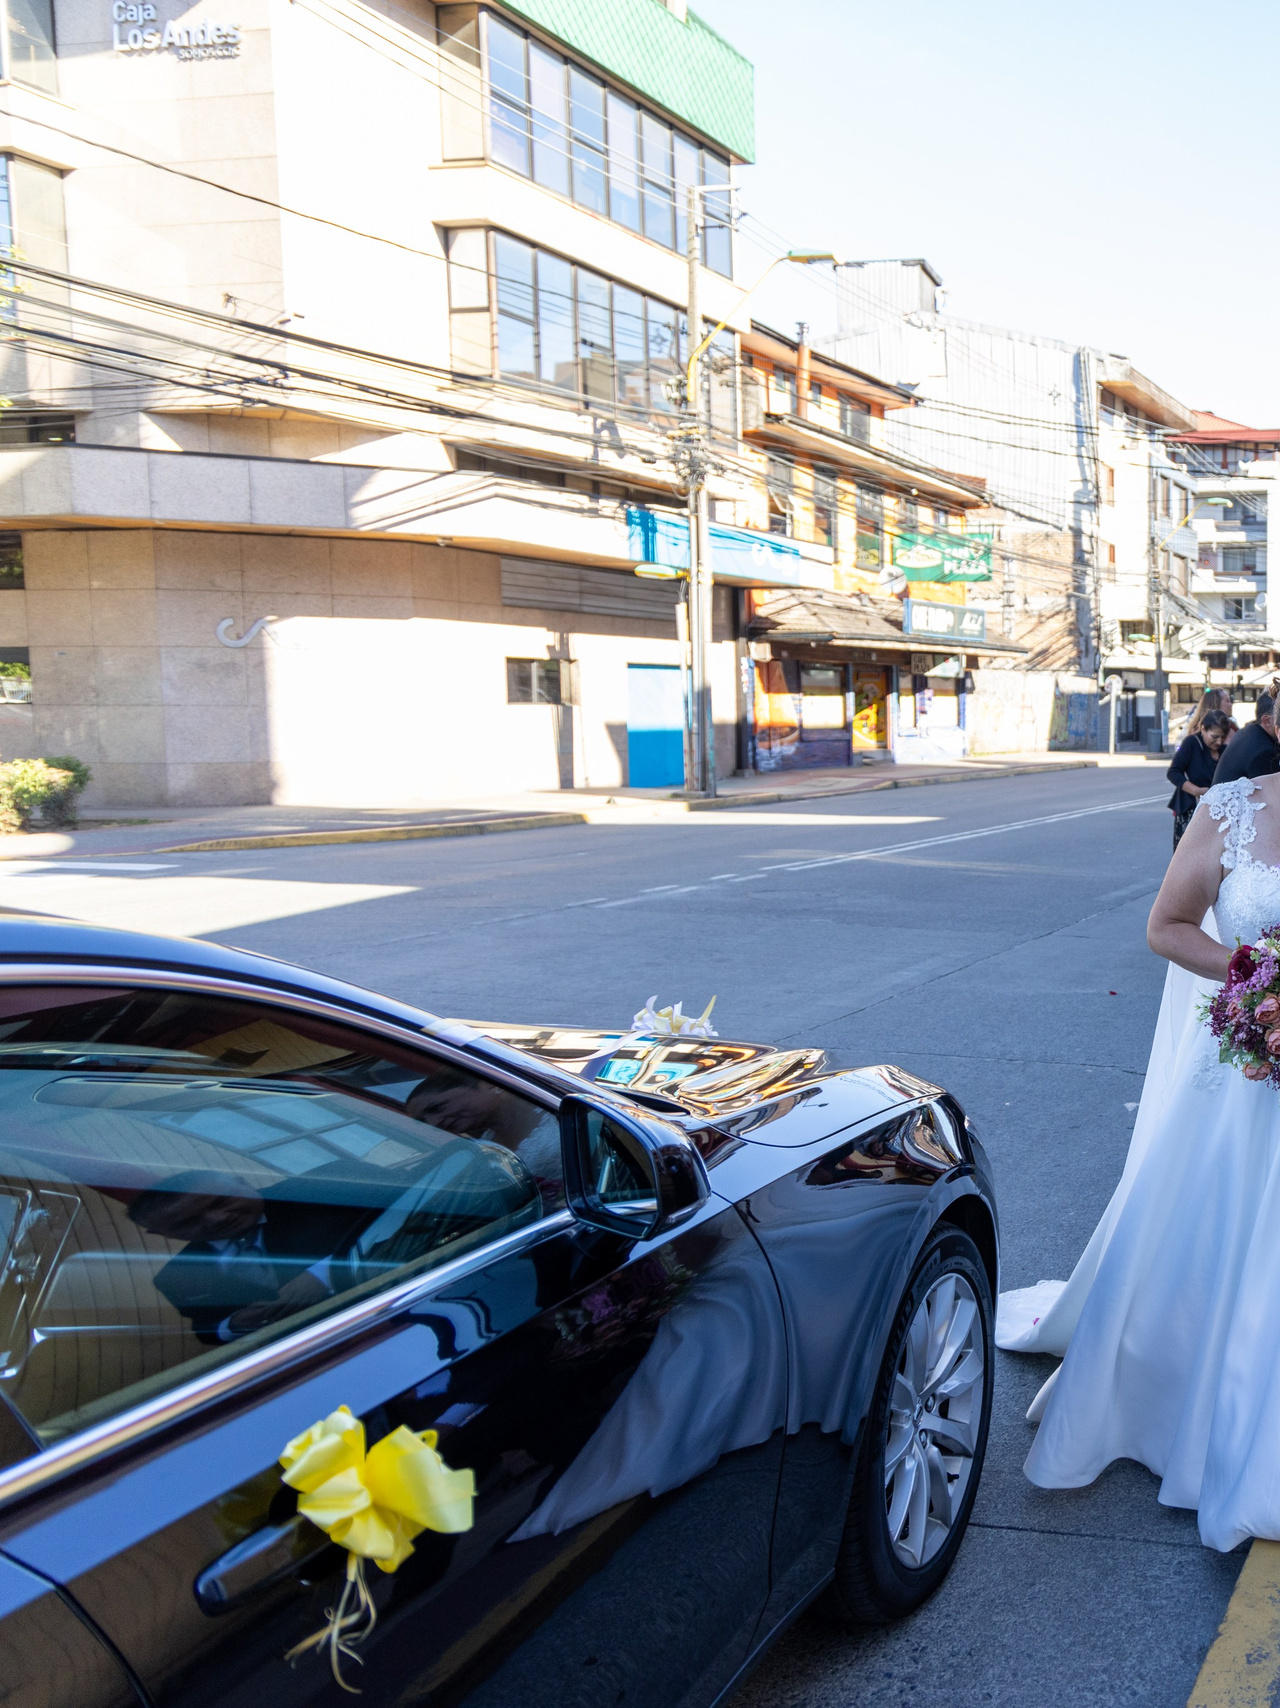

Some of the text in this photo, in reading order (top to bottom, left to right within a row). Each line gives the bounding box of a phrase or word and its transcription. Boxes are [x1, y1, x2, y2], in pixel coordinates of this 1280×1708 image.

[112, 0, 157, 26] Caja
[112, 18, 241, 51] Los Andes
[943, 559, 988, 574] PLAZA
